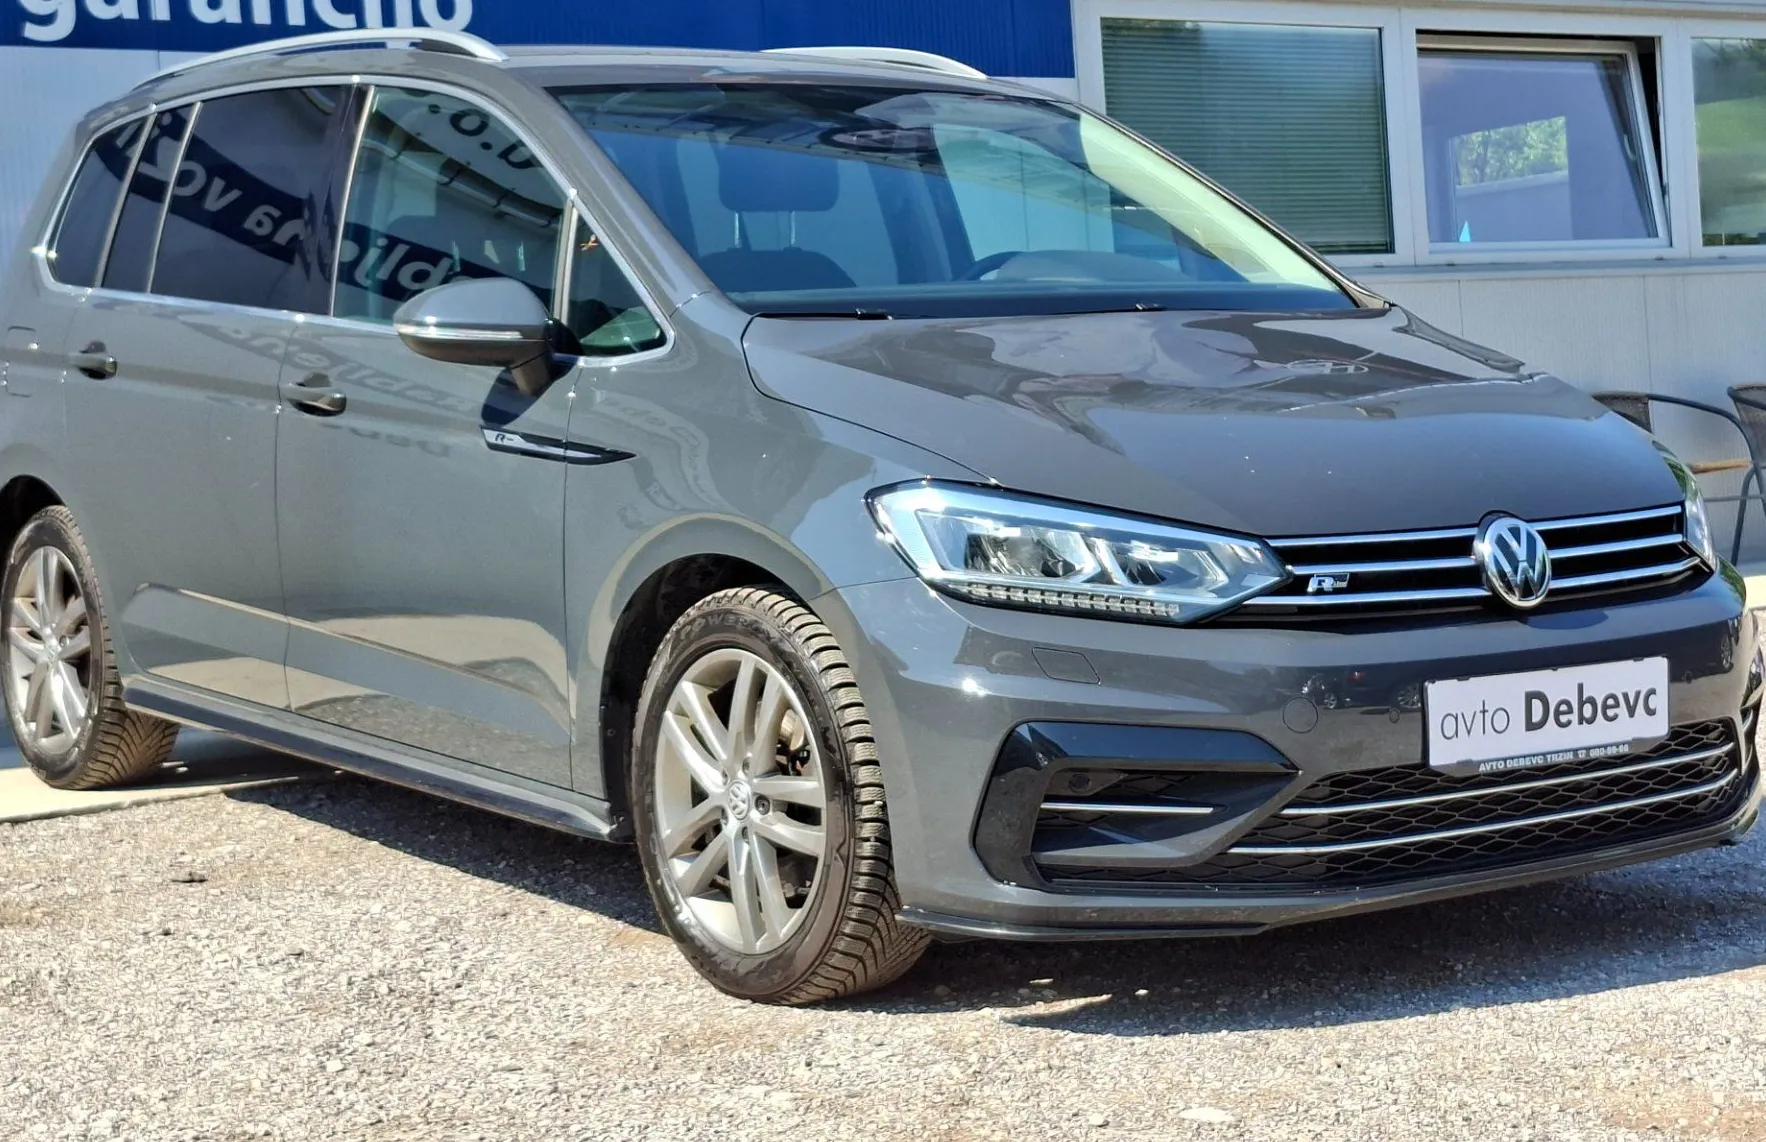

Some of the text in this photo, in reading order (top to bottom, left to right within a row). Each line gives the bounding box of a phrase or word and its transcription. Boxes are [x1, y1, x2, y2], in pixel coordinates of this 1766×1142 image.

[1440, 682, 1657, 740] avto Debevc
[1478, 761, 1505, 773] AVTO
